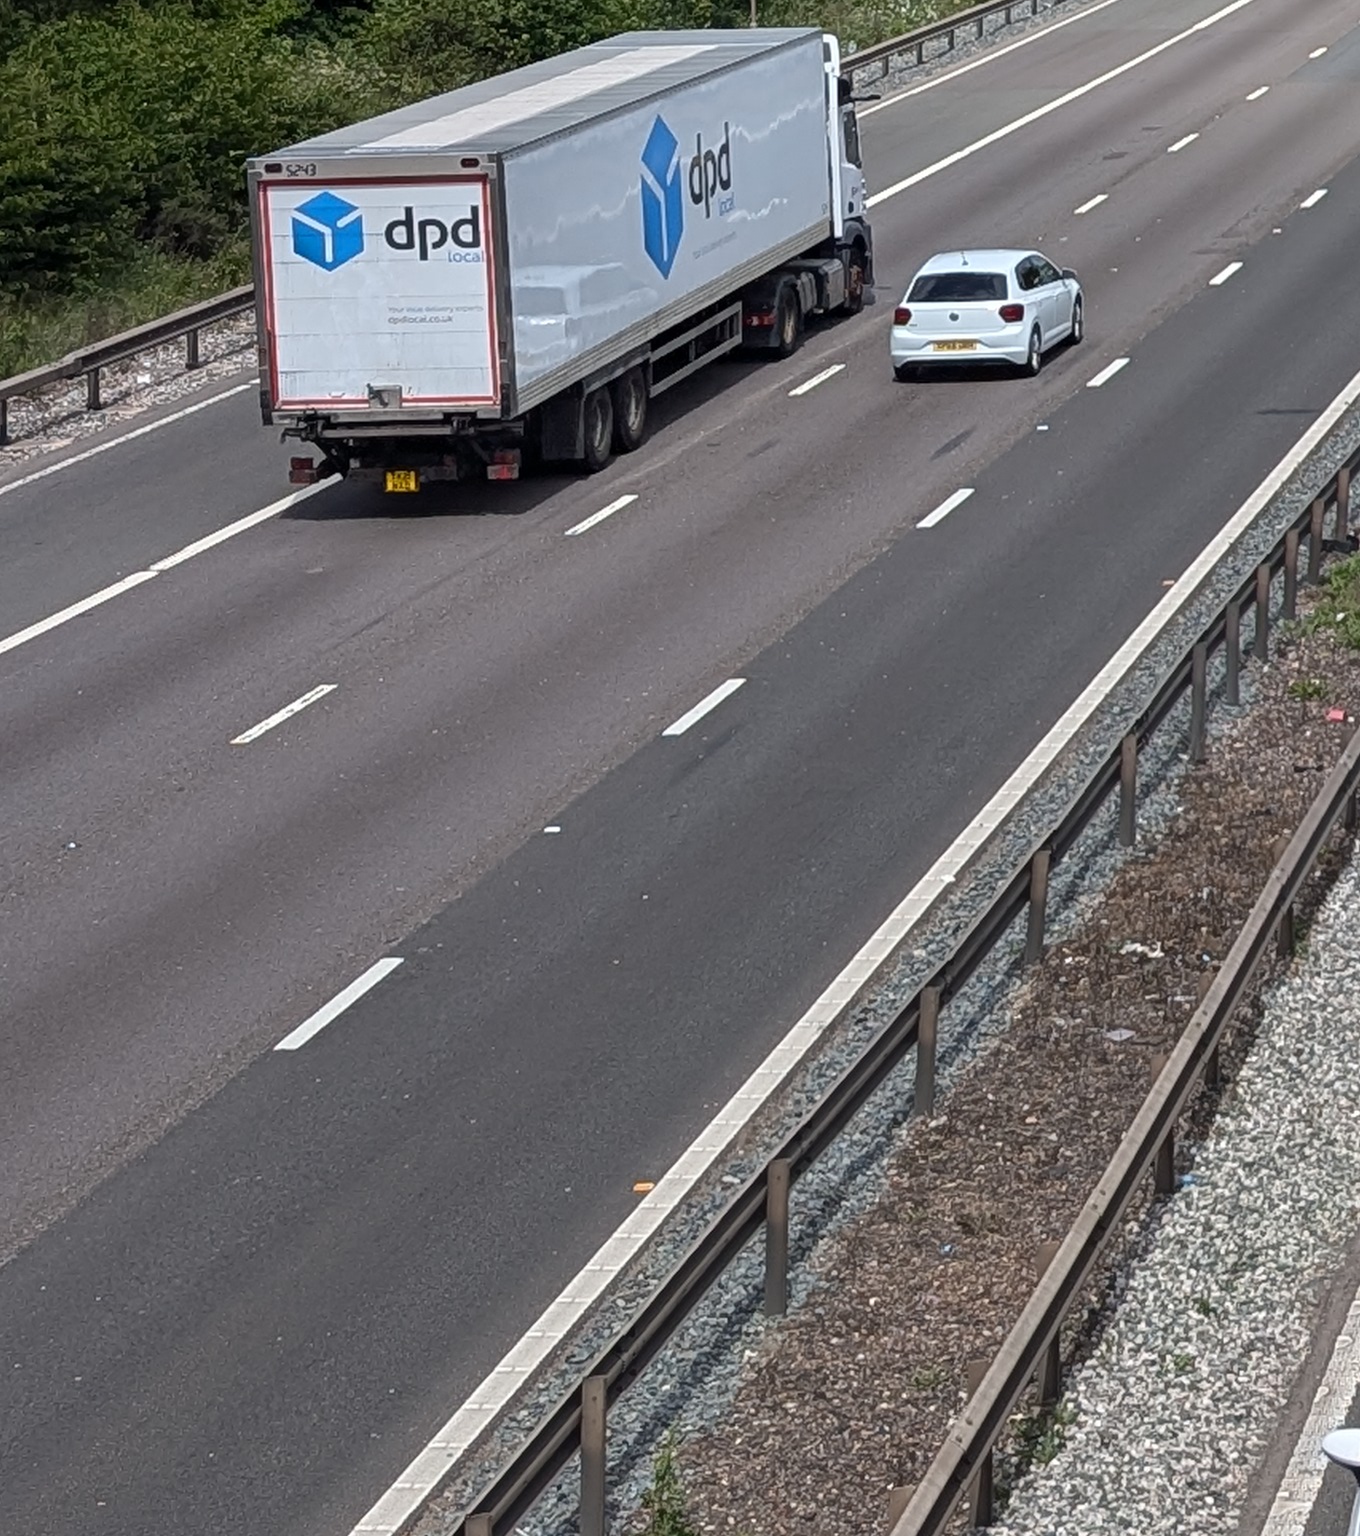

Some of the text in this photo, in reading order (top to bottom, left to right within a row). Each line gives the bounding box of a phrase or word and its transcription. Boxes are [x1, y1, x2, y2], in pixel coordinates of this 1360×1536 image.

[688, 121, 732, 220] dpd
[384, 205, 481, 261] dpd
[447, 250, 484, 263] local
